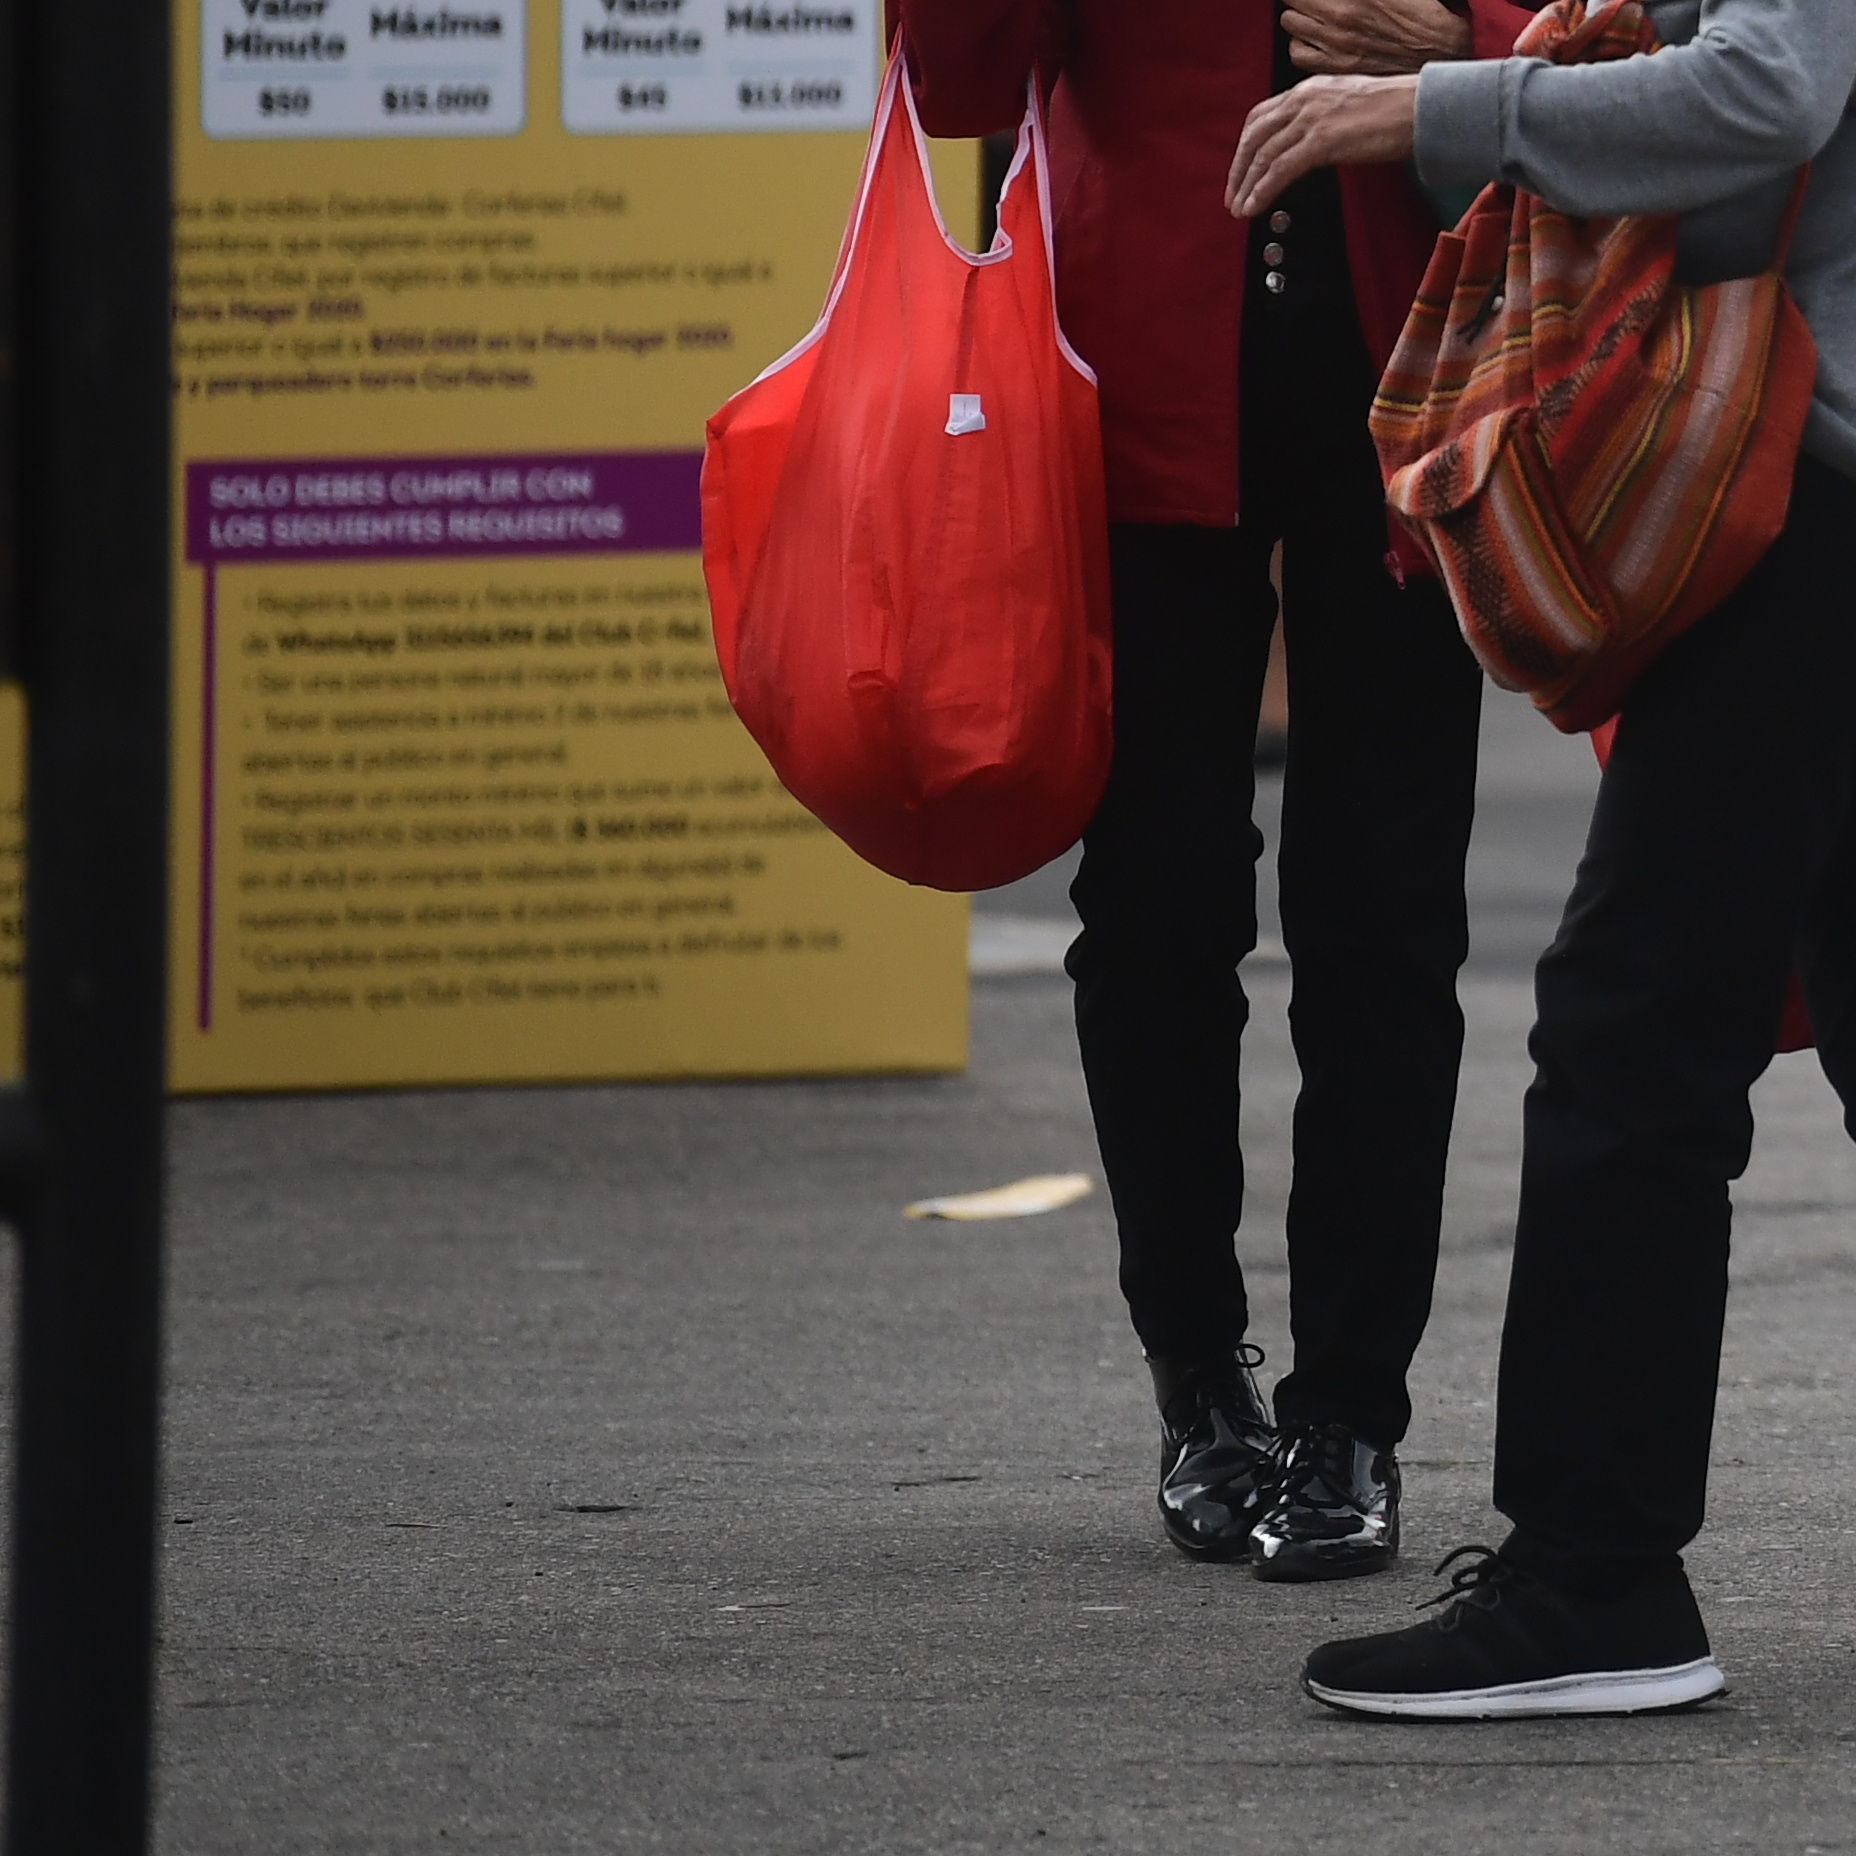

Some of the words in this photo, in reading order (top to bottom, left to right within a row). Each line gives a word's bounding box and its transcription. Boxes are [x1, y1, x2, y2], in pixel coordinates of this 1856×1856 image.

[370, 3, 504, 40] Máxima
[725, 0, 855, 36] Máxima
[223, 28, 347, 62] Minuto
[582, 24, 704, 57] Minuto
[210, 474, 289, 509] SOLO
[295, 471, 386, 506] DEBES
[391, 468, 521, 505] CUMPLIR
[526, 465, 594, 501] CON
[209, 513, 268, 548] LOS
[272, 508, 443, 546] SIGUIENTES
[448, 504, 625, 543] REQUISITOS
